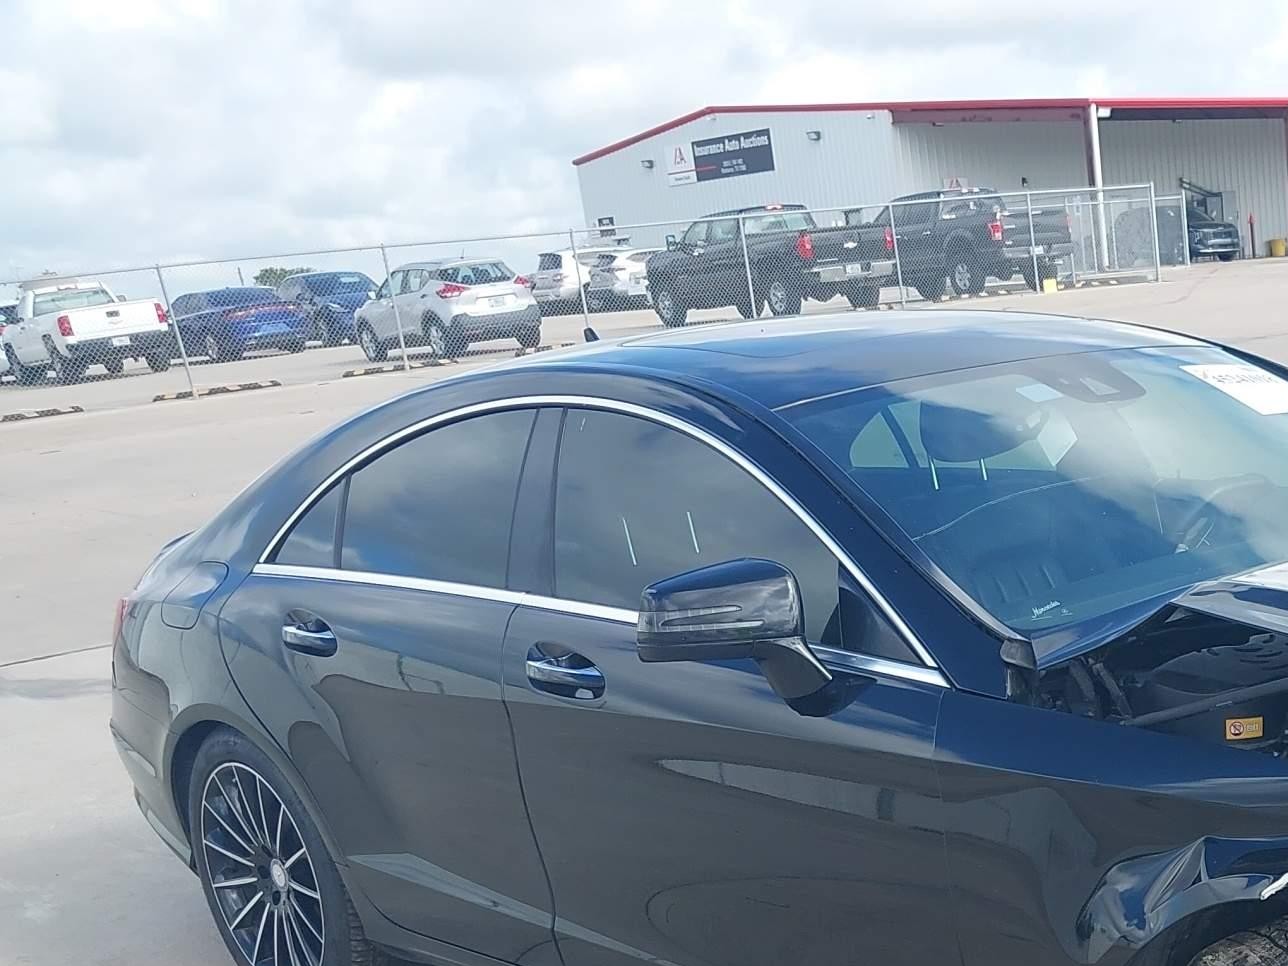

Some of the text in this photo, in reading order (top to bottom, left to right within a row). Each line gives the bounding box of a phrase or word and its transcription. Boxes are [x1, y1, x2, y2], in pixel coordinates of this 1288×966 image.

[694, 133, 769, 157] Insurance Auto Auctions
